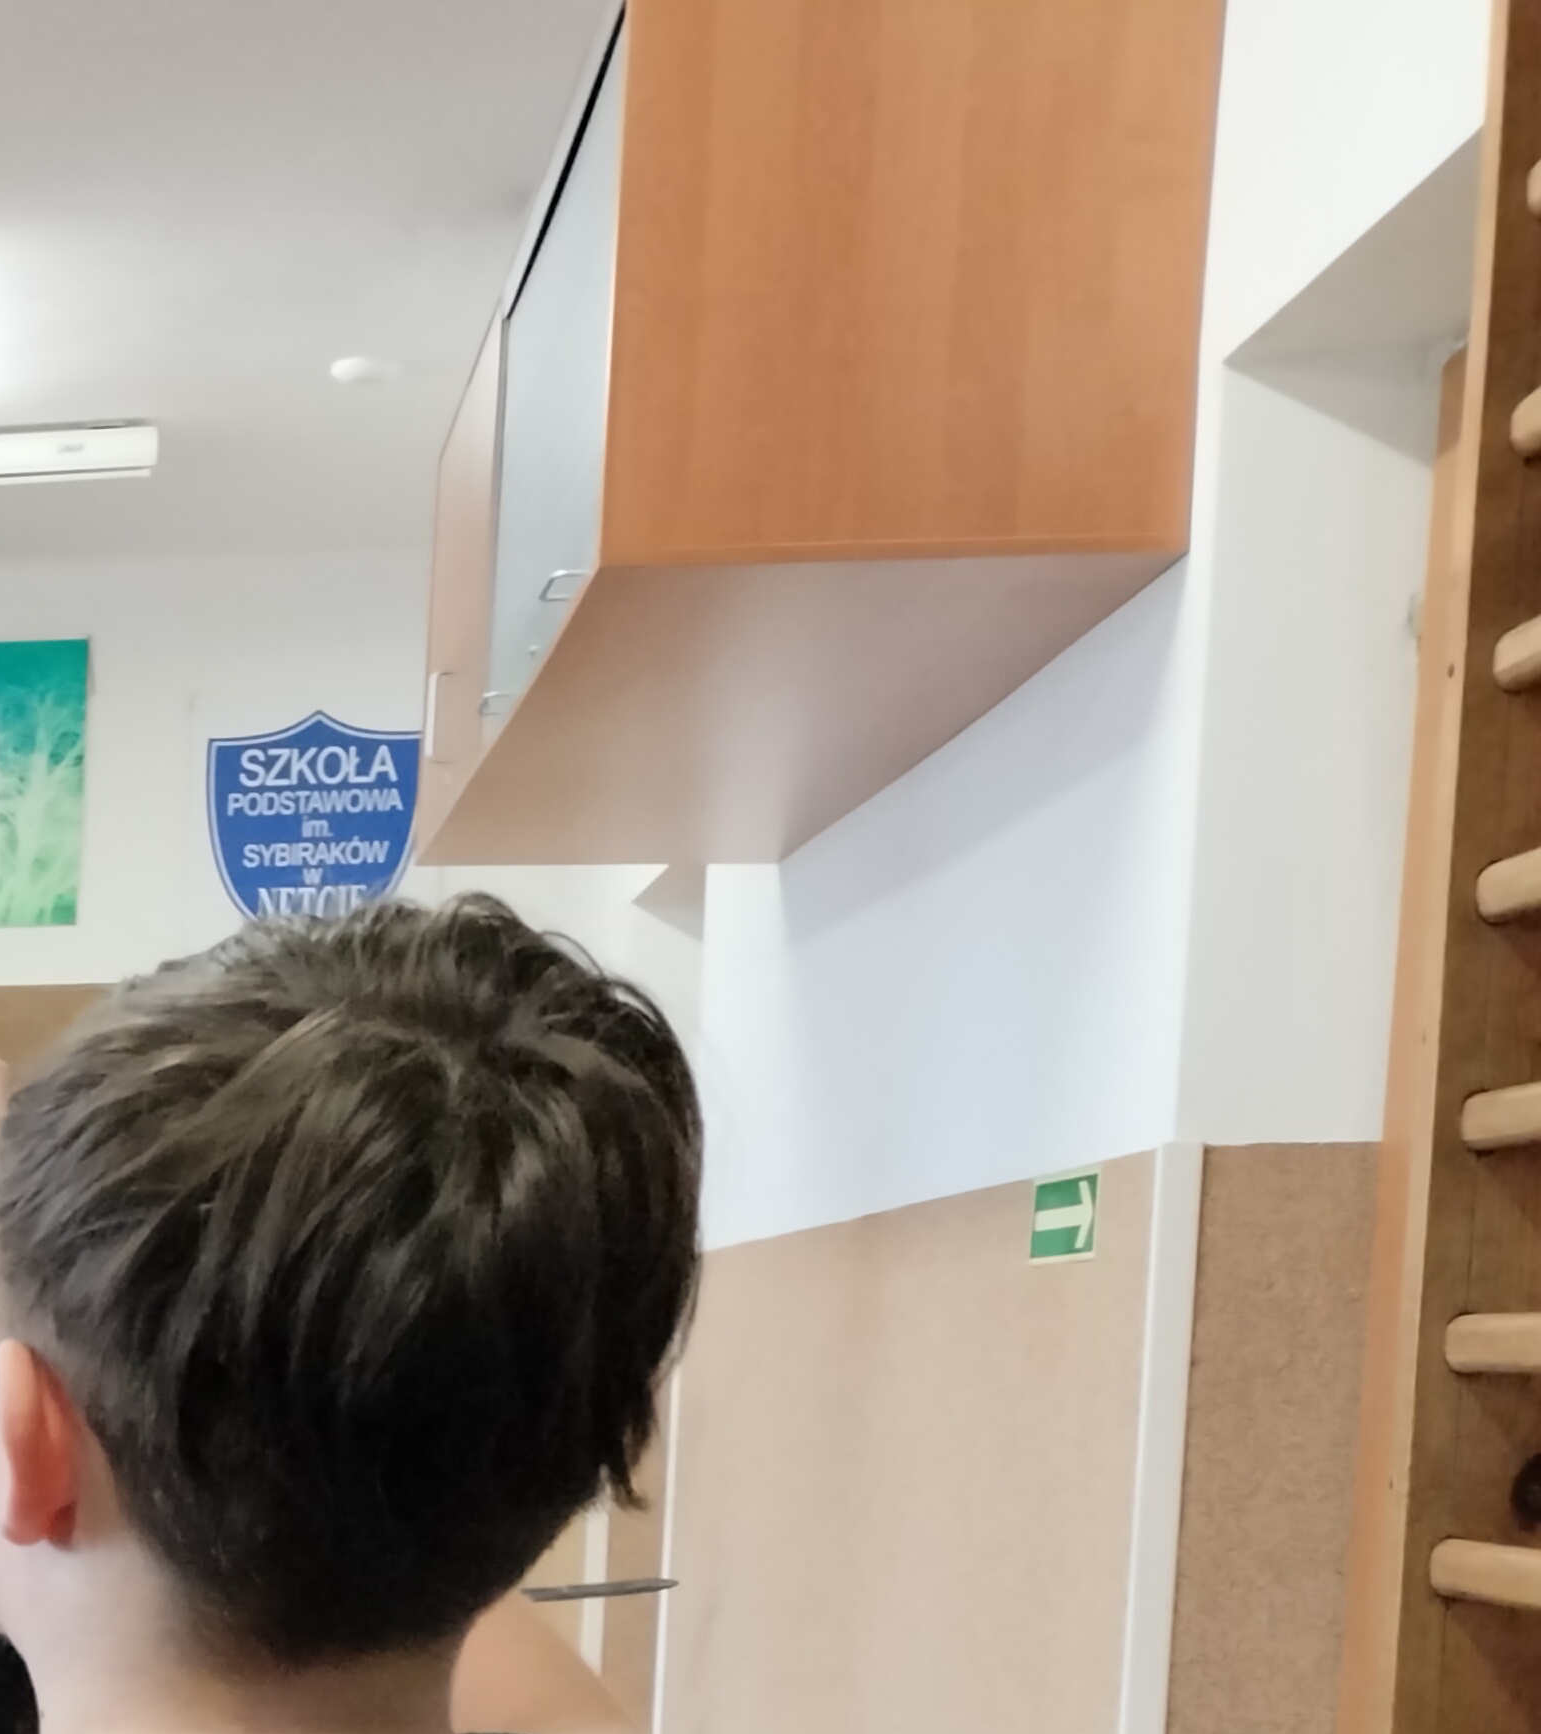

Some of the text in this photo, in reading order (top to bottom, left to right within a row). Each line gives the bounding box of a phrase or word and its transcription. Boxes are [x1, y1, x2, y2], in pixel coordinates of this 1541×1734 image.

[239, 744, 399, 787] SZKOŁA
[227, 789, 403, 816] PODSTAWOWA
[303, 817, 332, 837] im.
[242, 836, 390, 868] SYBIRAKÓW
